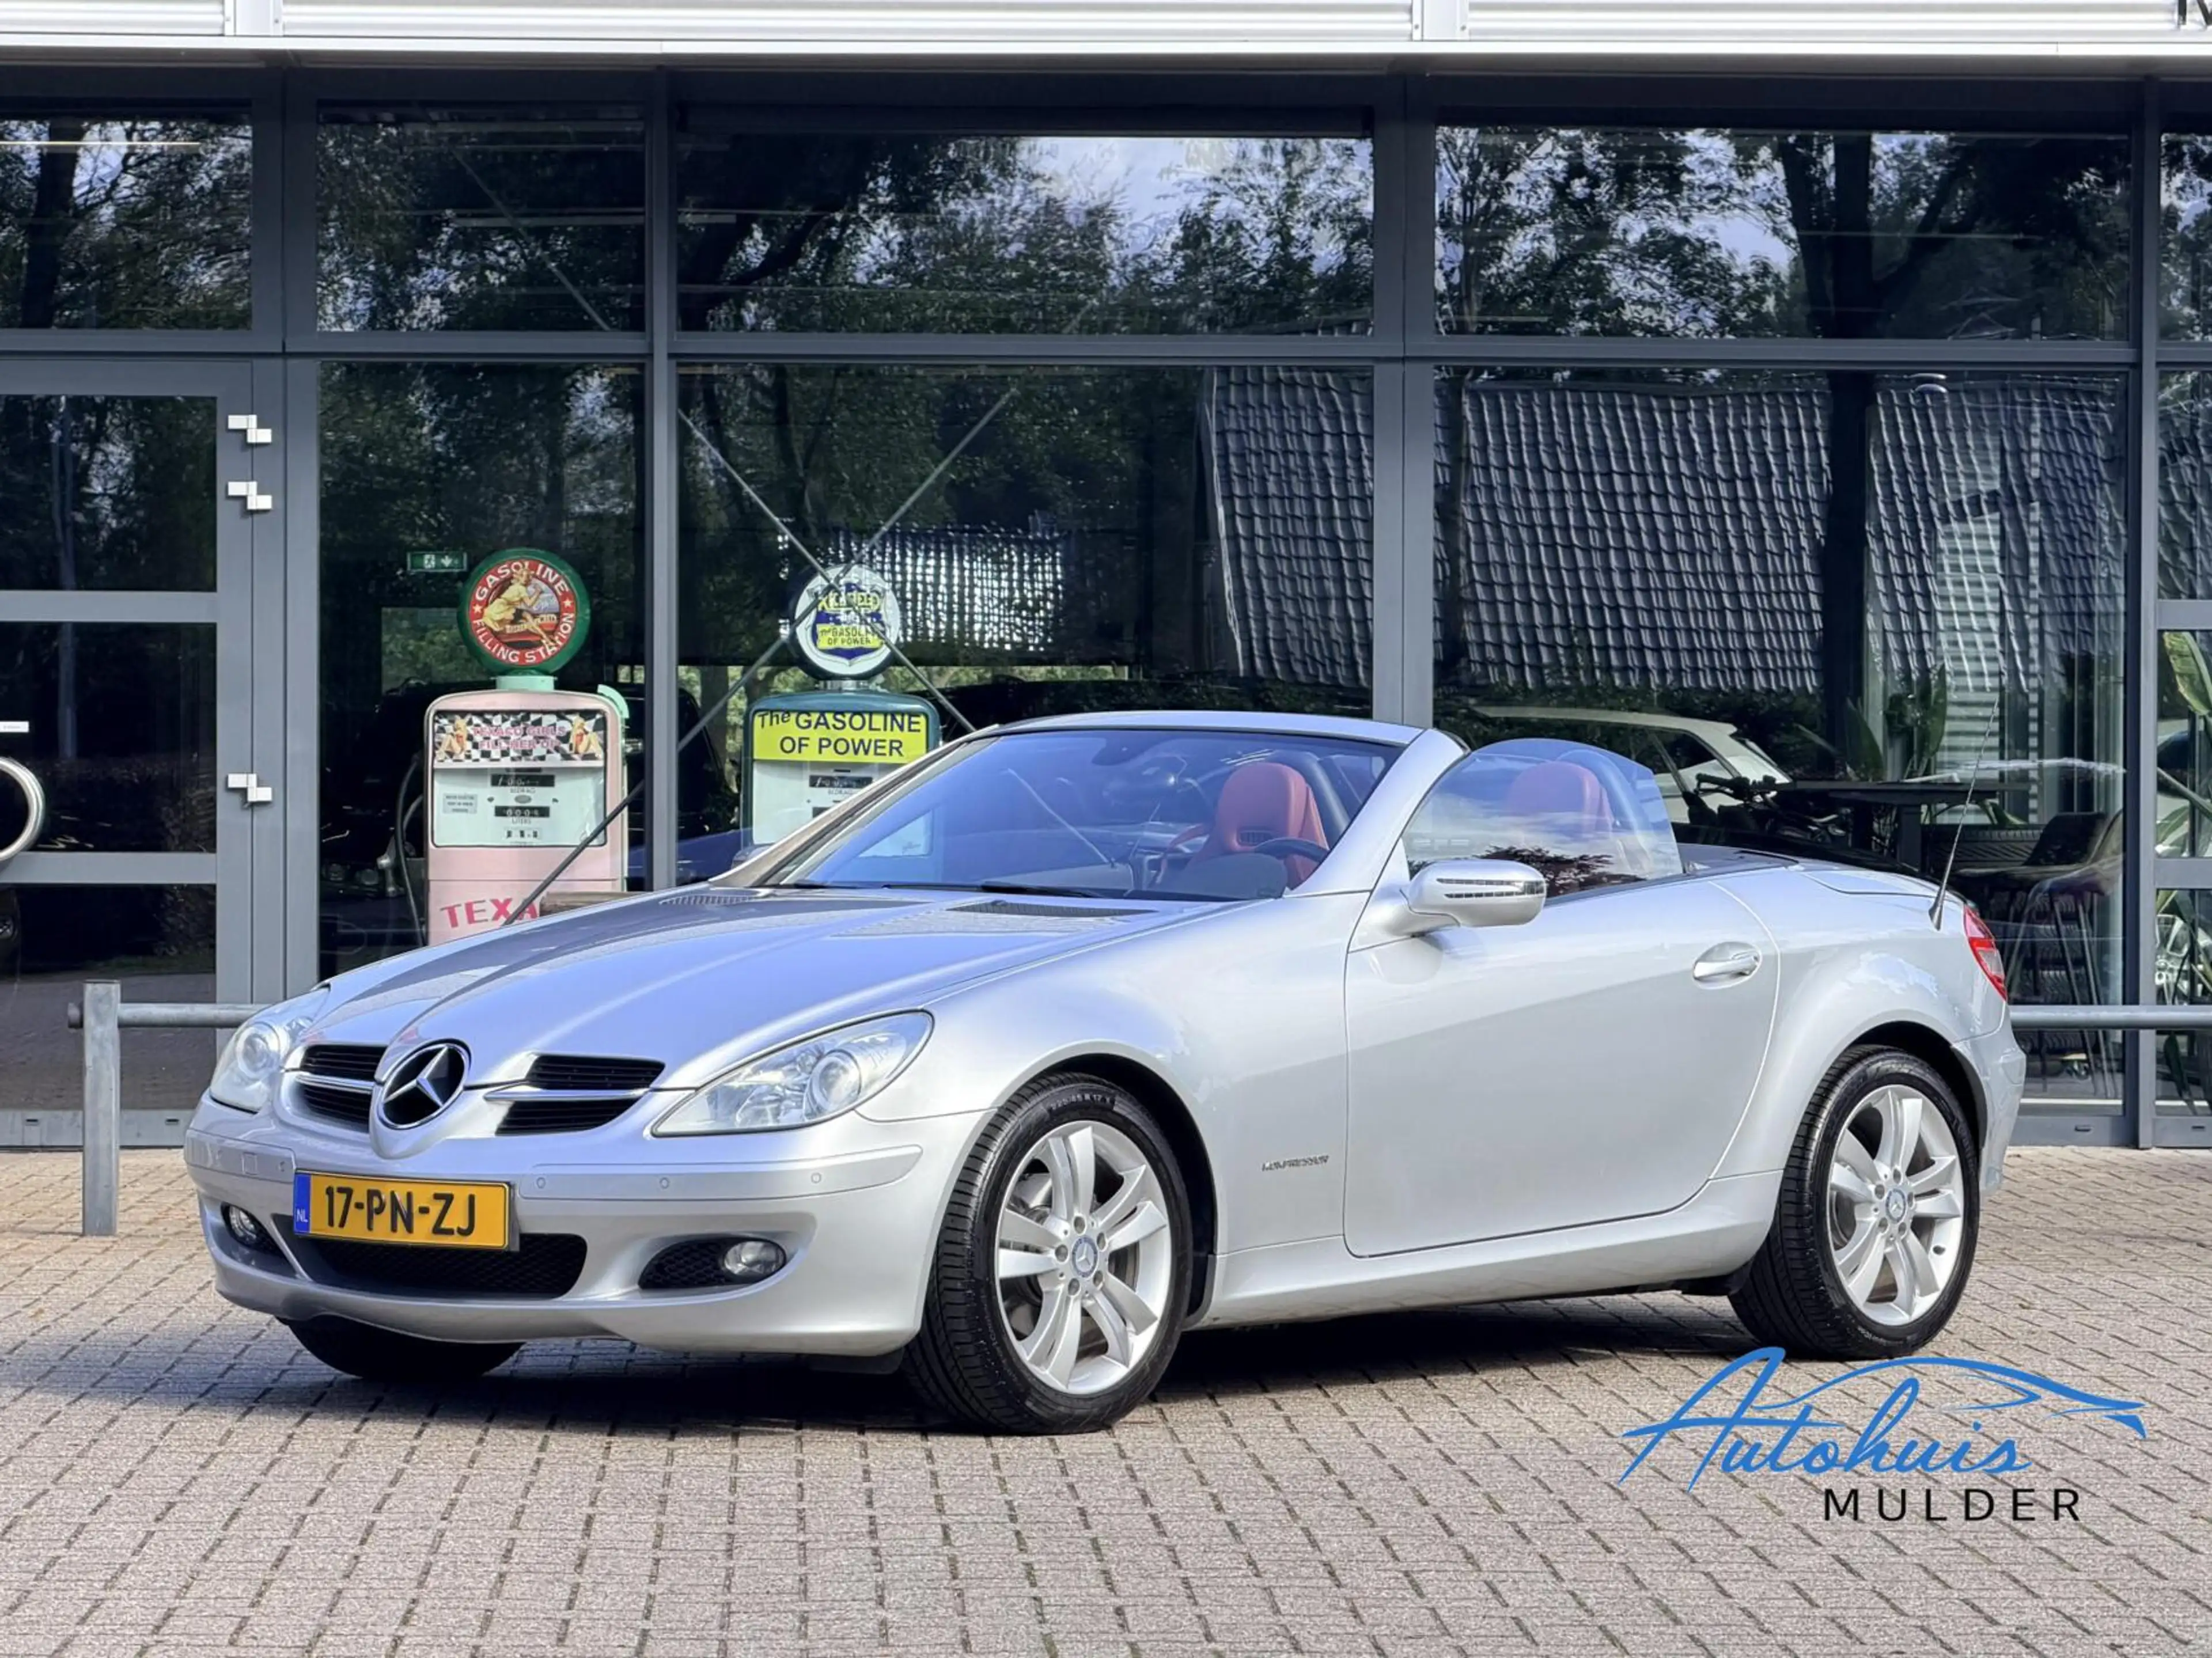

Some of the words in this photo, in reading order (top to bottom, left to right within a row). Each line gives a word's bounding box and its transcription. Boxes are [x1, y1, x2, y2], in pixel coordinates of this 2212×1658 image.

[474, 561, 569, 602] GASOLINE
[472, 618, 521, 662] FILLING
[525, 612, 574, 664] STATION
[758, 711, 790, 729] The
[795, 711, 921, 733] GASOLINE
[780, 736, 810, 754] OF
[818, 738, 904, 757] POWER
[296, 1209, 308, 1223] NL
[325, 1186, 475, 1236] 17-PN-ZJ
